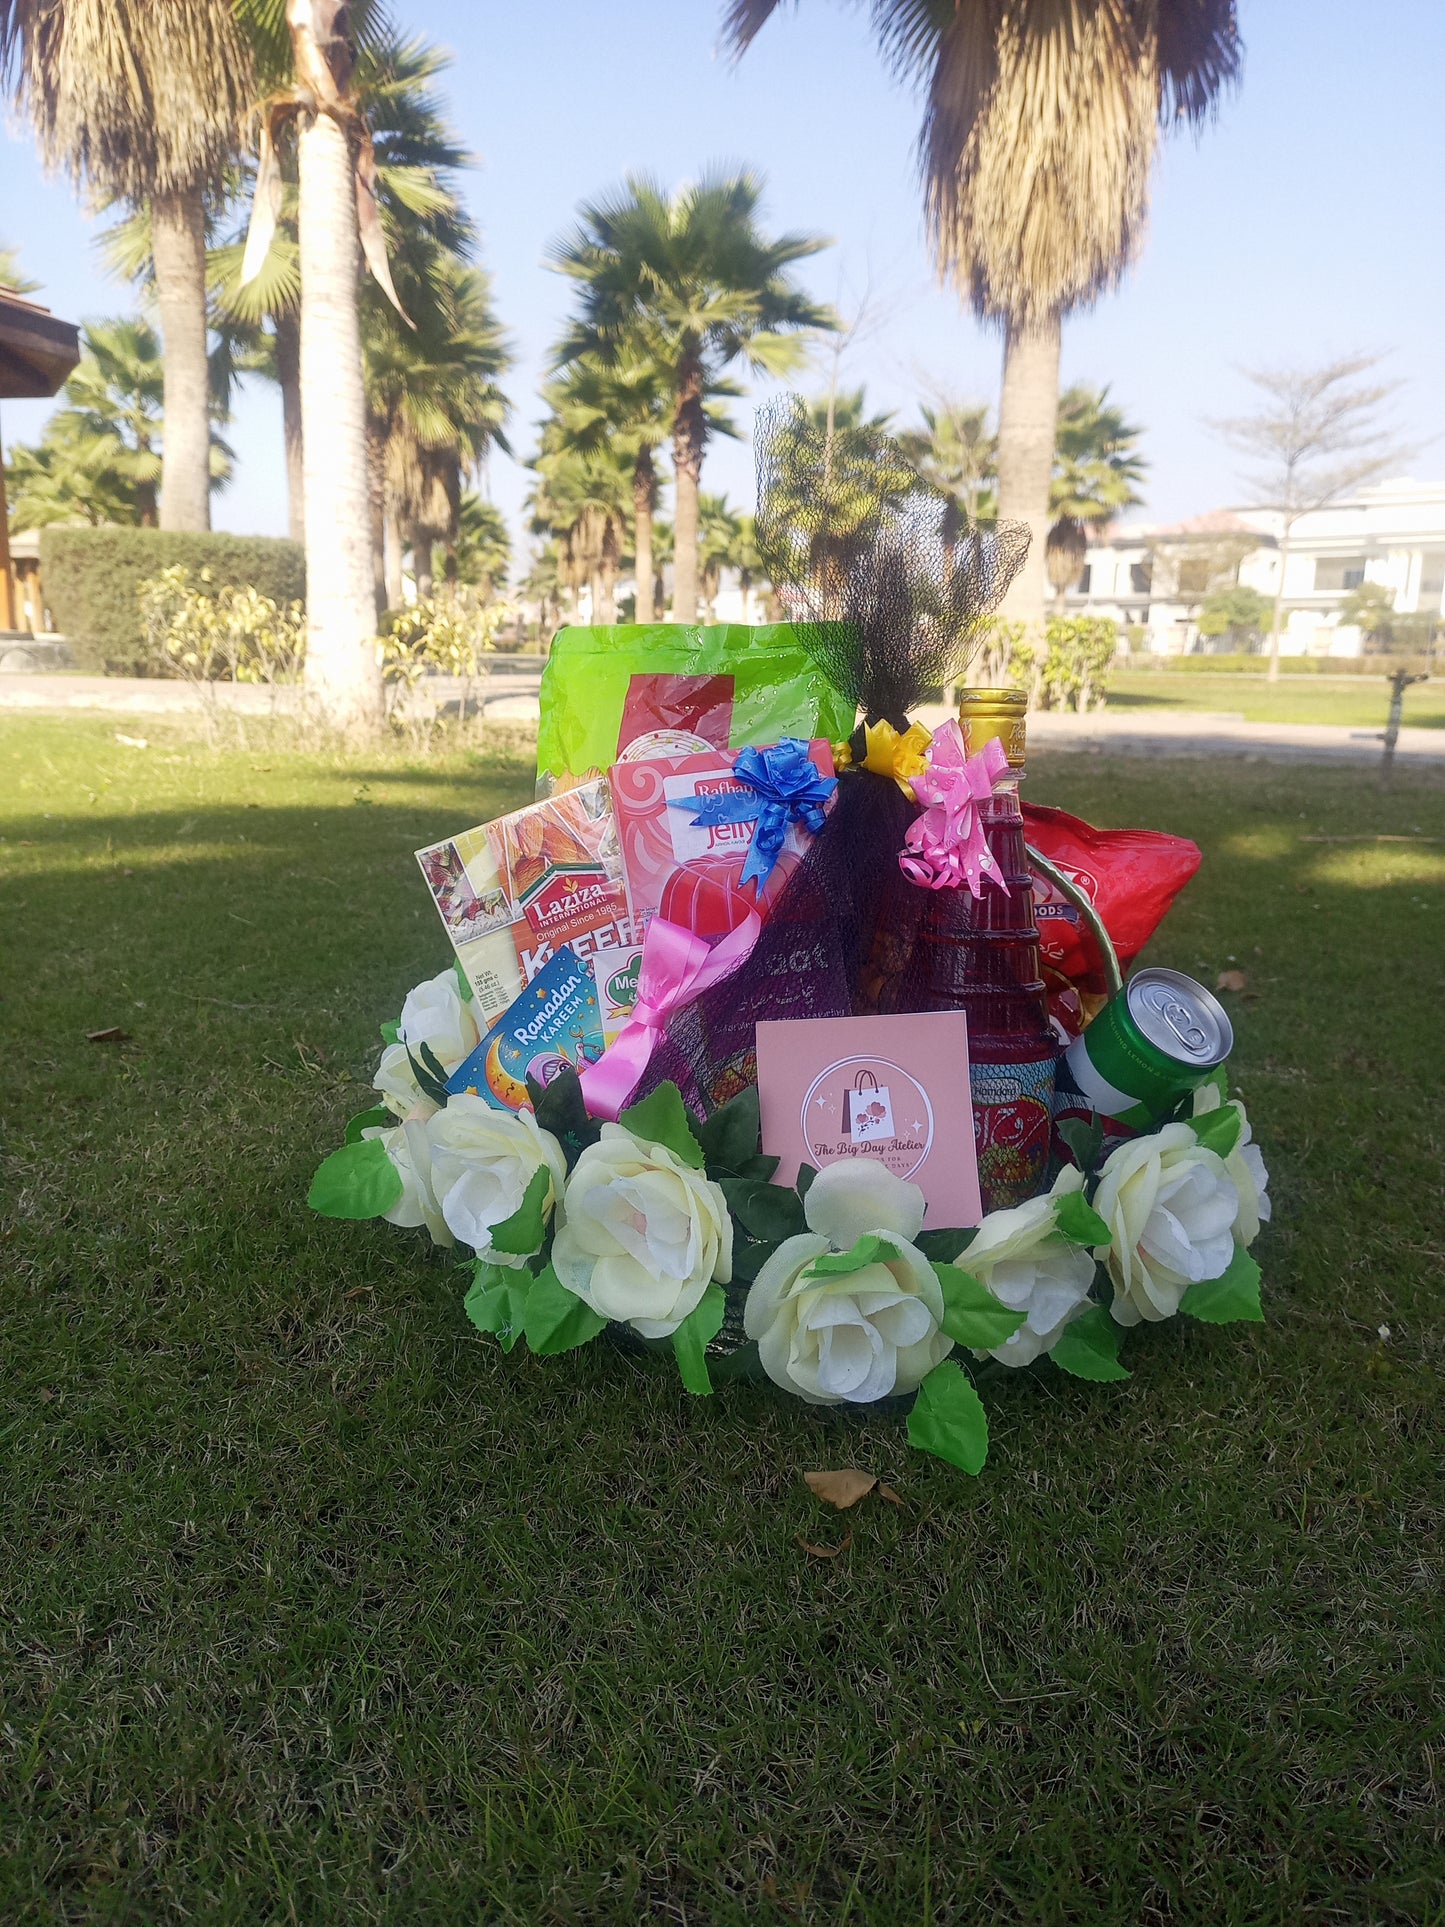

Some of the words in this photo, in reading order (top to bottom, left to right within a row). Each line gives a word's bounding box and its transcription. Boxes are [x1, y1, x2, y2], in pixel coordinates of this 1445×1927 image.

[707, 820, 758, 849] Jelly
[532, 883, 605, 921] Laziza
[539, 895, 608, 928] INTERNATIONAL
[536, 921, 569, 941] Original
[571, 914, 594, 928] Since
[596, 902, 617, 917] 1985
[513, 975, 581, 1045] Ramadan
[540, 995, 583, 1043] KAREEM
[814, 1143, 835, 1156] The
[837, 1141, 859, 1156] Big
[860, 1140, 885, 1155] Day
[887, 1138, 925, 1152] Atelier
